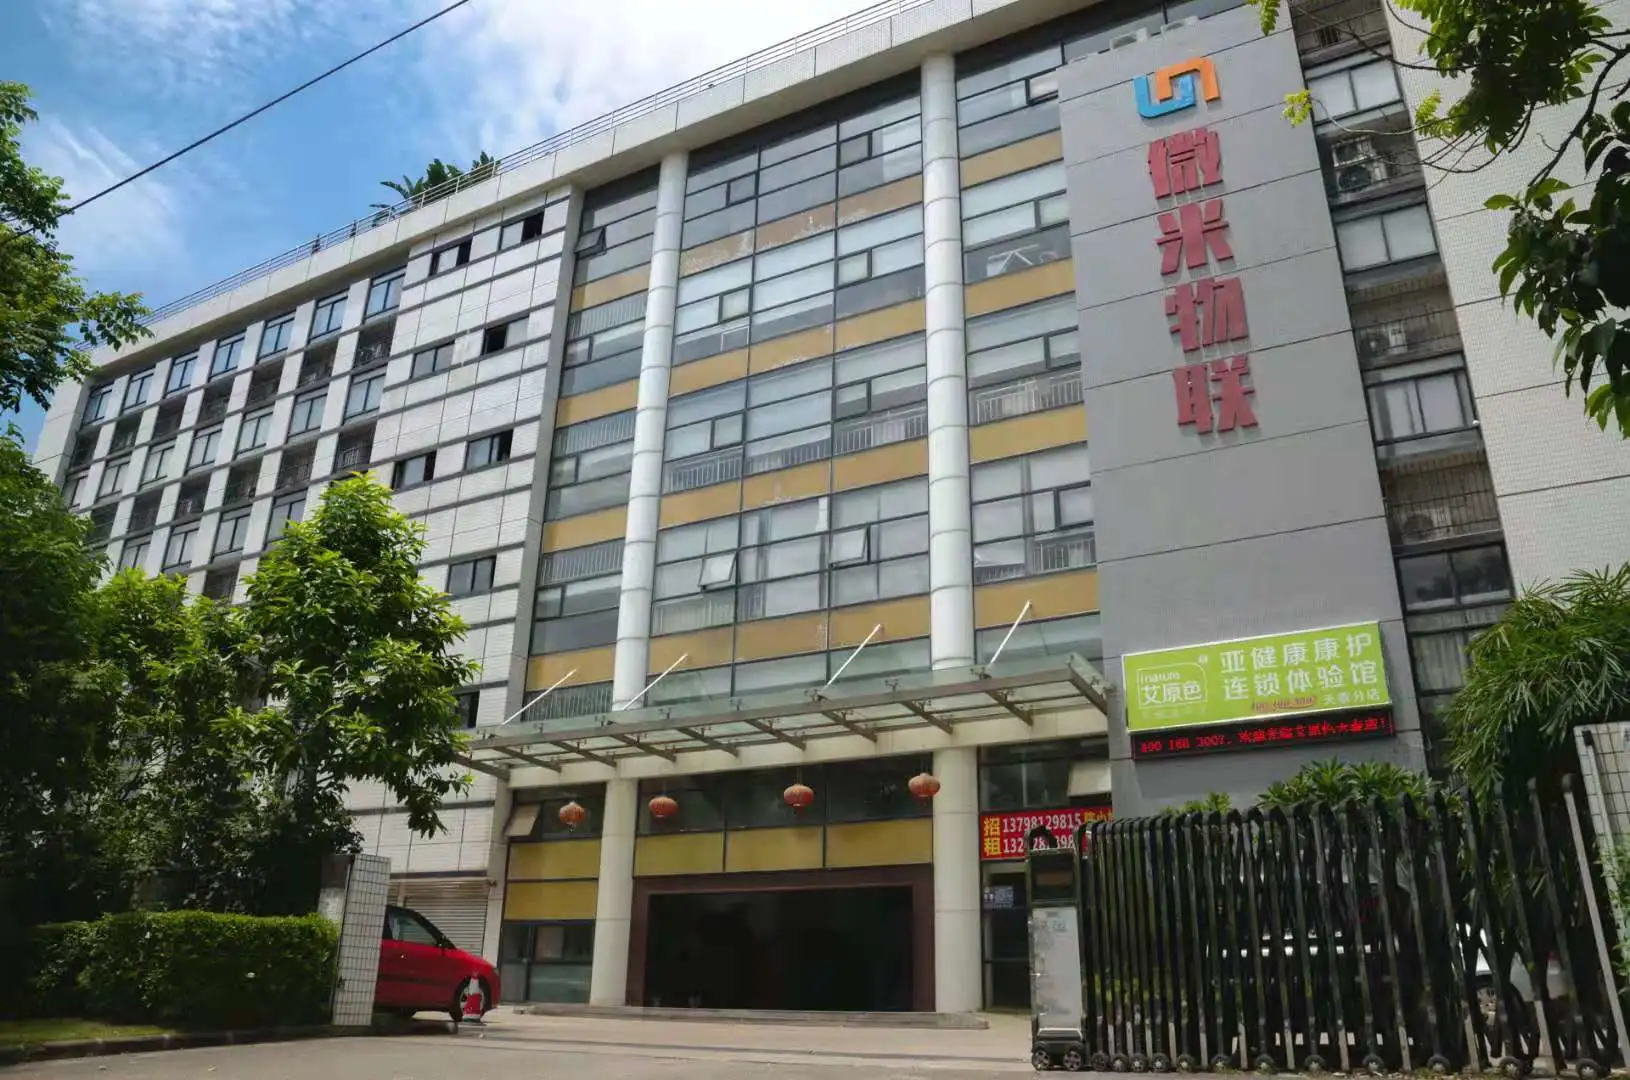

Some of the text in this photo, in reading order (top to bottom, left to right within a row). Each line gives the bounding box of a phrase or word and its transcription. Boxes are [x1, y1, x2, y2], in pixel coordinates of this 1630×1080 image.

[1148, 127, 1259, 434] 微米物联
[1219, 632, 1372, 674] 亚健康康护
[1140, 680, 1202, 705] 艾原色
[1223, 660, 1377, 701] 连锁体验馆
[983, 817, 1001, 857] 招租
[1002, 812, 1082, 833] 13798129815
